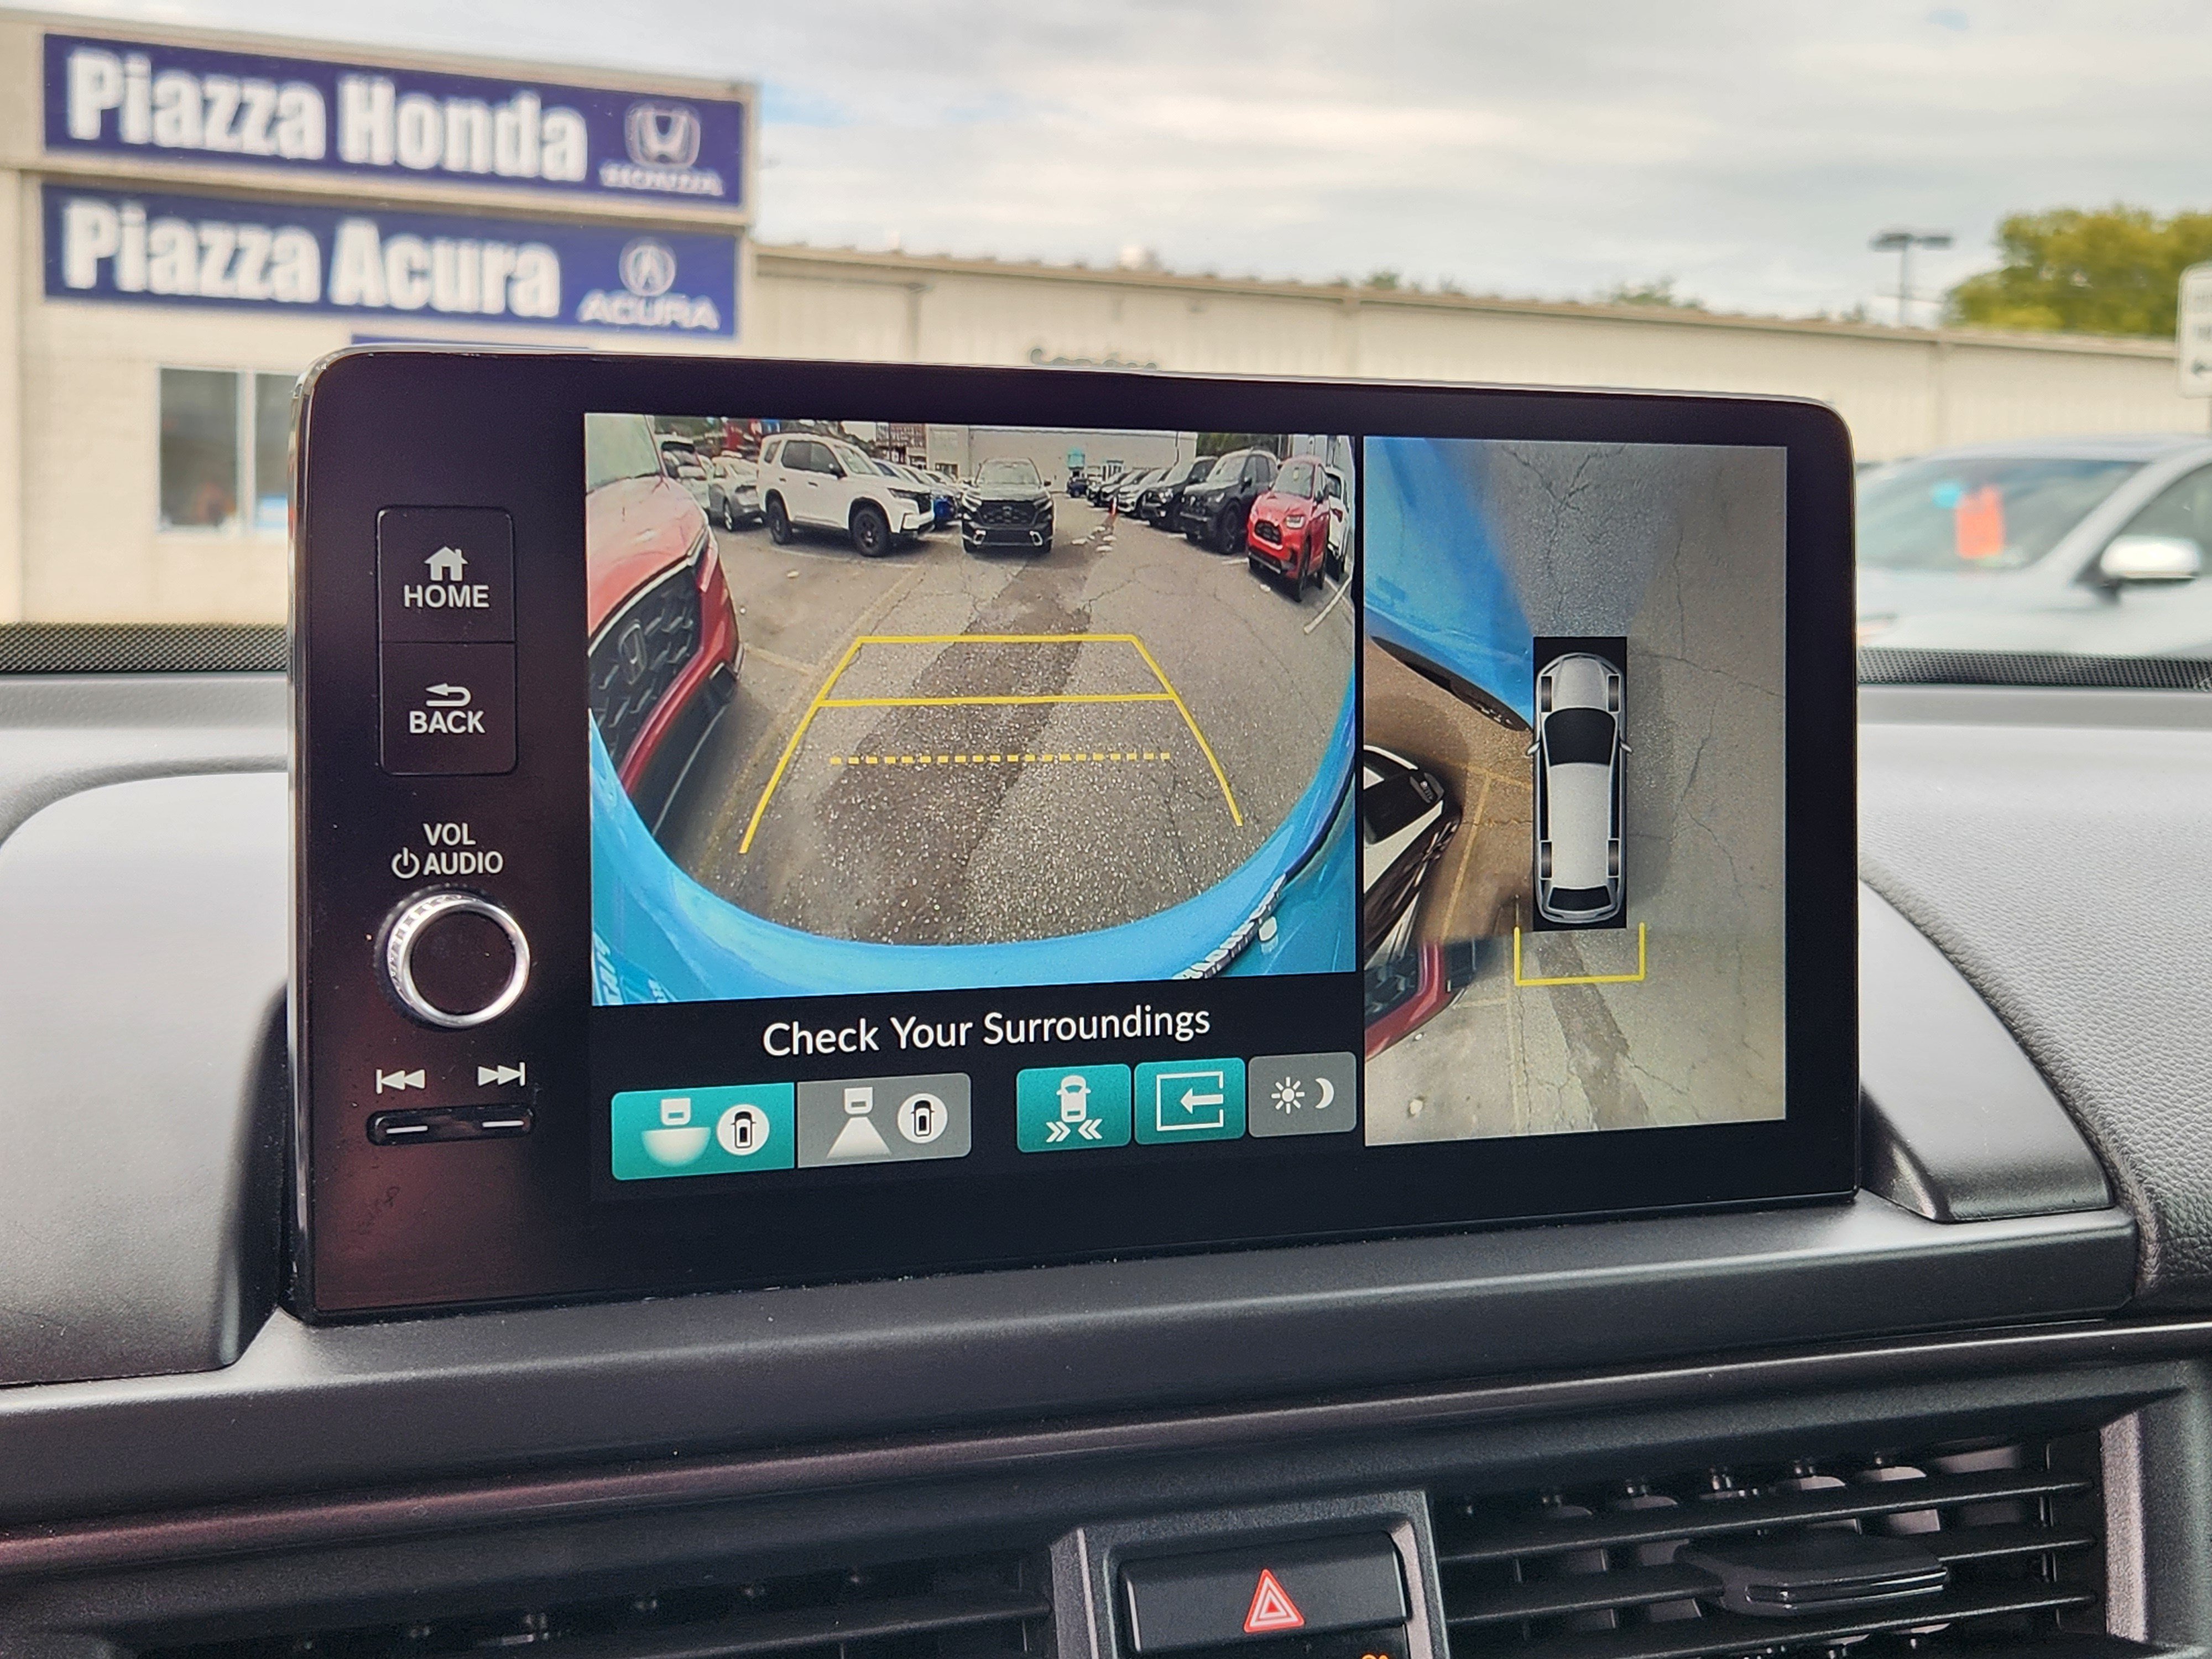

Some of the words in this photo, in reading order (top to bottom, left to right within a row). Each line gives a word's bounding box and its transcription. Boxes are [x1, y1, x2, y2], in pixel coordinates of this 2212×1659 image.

[67, 50, 326, 160] Piazza
[337, 75, 588, 182] Honda
[62, 200, 321, 303] Piazza
[329, 221, 561, 318] Acura
[576, 289, 721, 331] ACURA
[404, 584, 490, 608] HOME
[409, 711, 486, 734] BACK
[423, 822, 476, 846] VOL
[422, 851, 504, 875] AUDIO
[763, 1018, 880, 1056] Check
[890, 1016, 973, 1050] Your
[983, 1004, 1211, 1044] Surroundings
